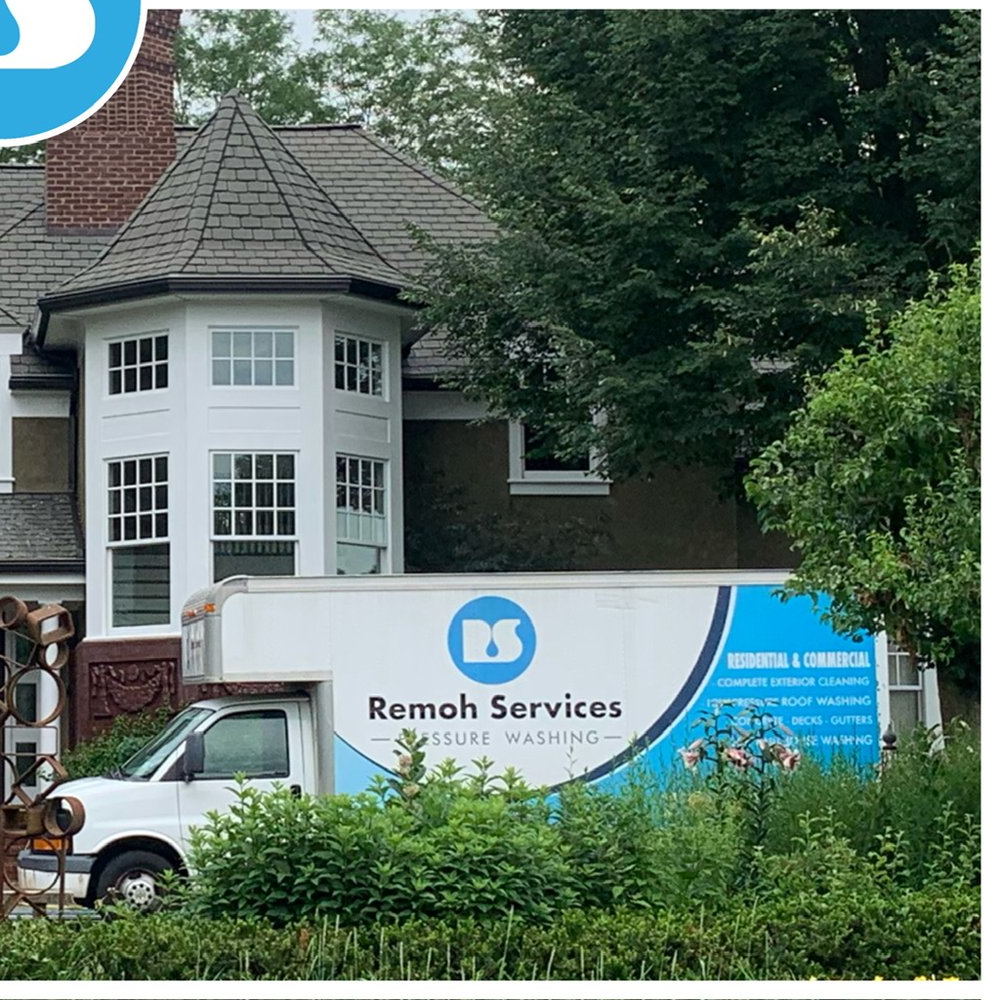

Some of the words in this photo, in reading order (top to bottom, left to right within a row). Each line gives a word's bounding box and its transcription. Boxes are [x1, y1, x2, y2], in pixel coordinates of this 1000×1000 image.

[727, 652, 789, 669] RESIDENTIAL
[791, 653, 801, 668] &
[803, 651, 871, 668] COMMERCIAL
[717, 677, 768, 688] COMPLETE
[770, 677, 816, 688] EXTERIOR
[818, 676, 870, 687] CLEANING
[369, 693, 478, 720] Remoh
[490, 693, 622, 719] Services
[781, 697, 813, 707] ROOF
[816, 696, 872, 707] WASHING
[791, 716, 823, 726] DECKS
[831, 715, 873, 725] GUTTERS
[505, 730, 600, 745] WASHING
[822, 735, 873, 746] WASHING
